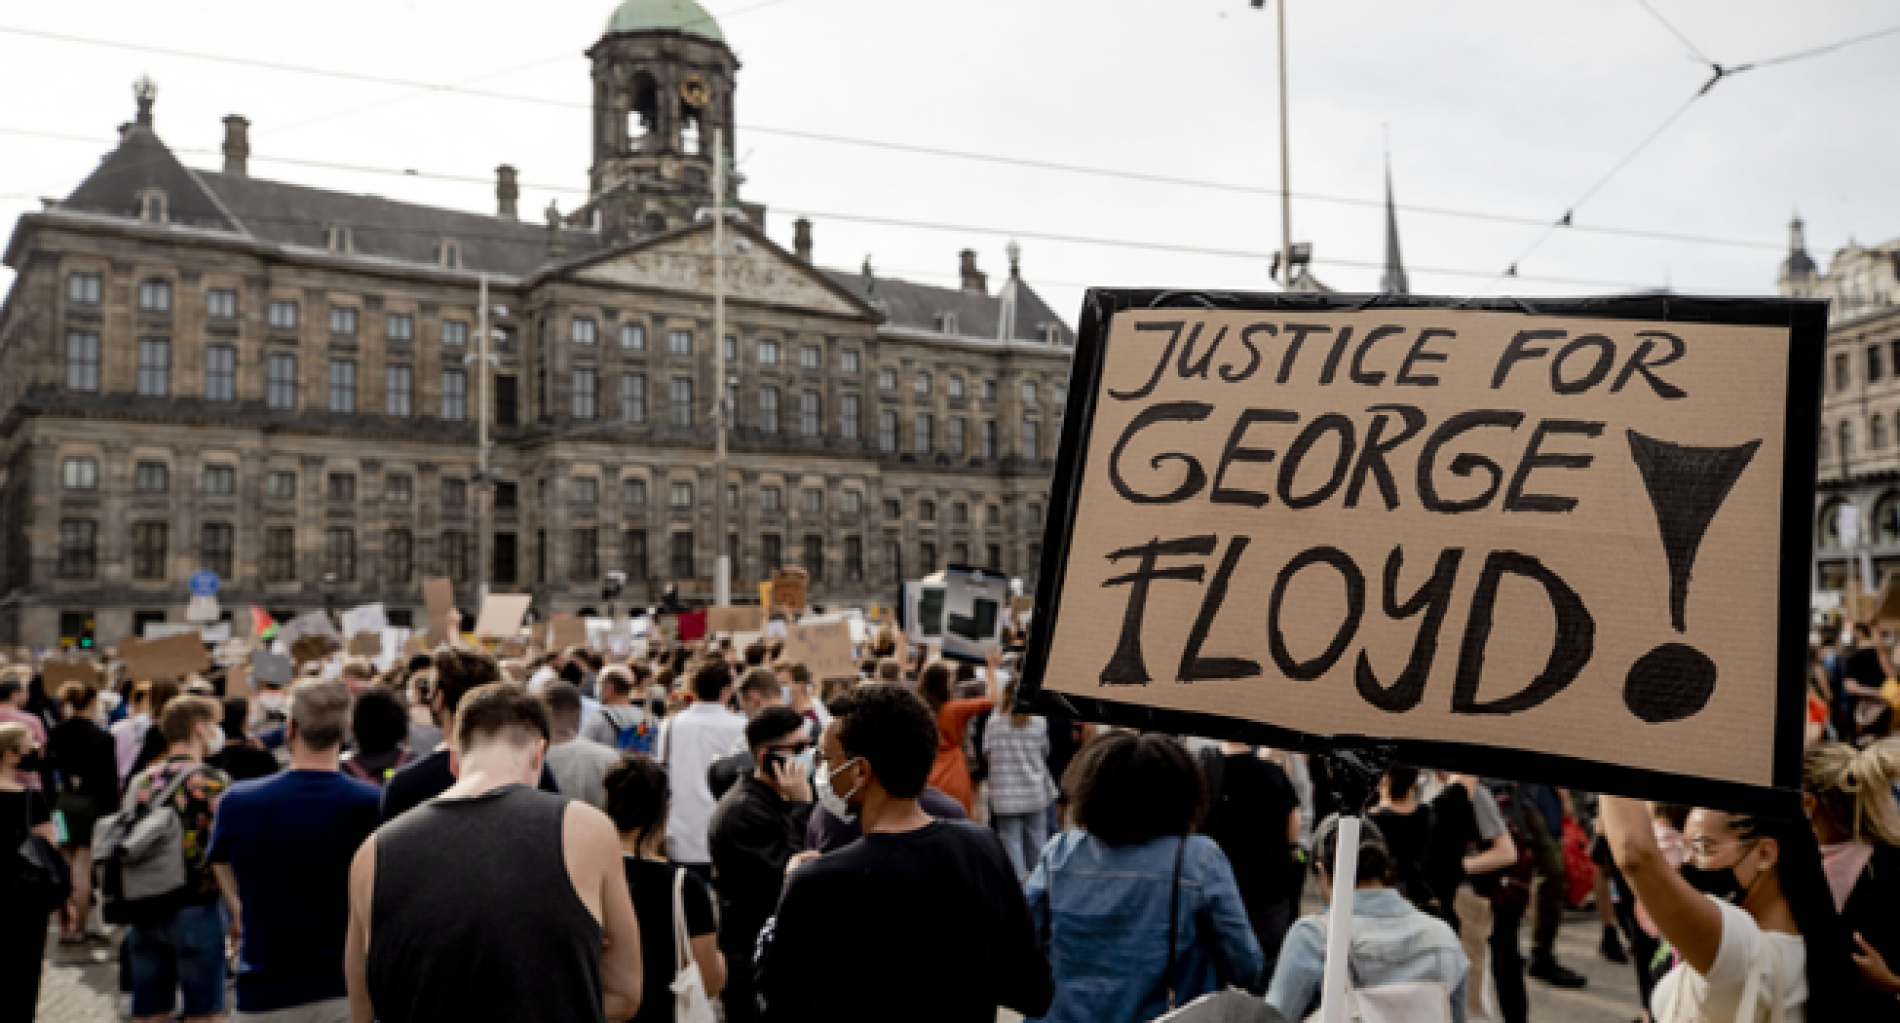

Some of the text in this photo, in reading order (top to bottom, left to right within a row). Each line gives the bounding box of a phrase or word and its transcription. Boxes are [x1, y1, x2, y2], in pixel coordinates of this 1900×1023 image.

[1107, 320, 1688, 402] JUSTICE FOR
[1107, 400, 1606, 513] GEORGE
